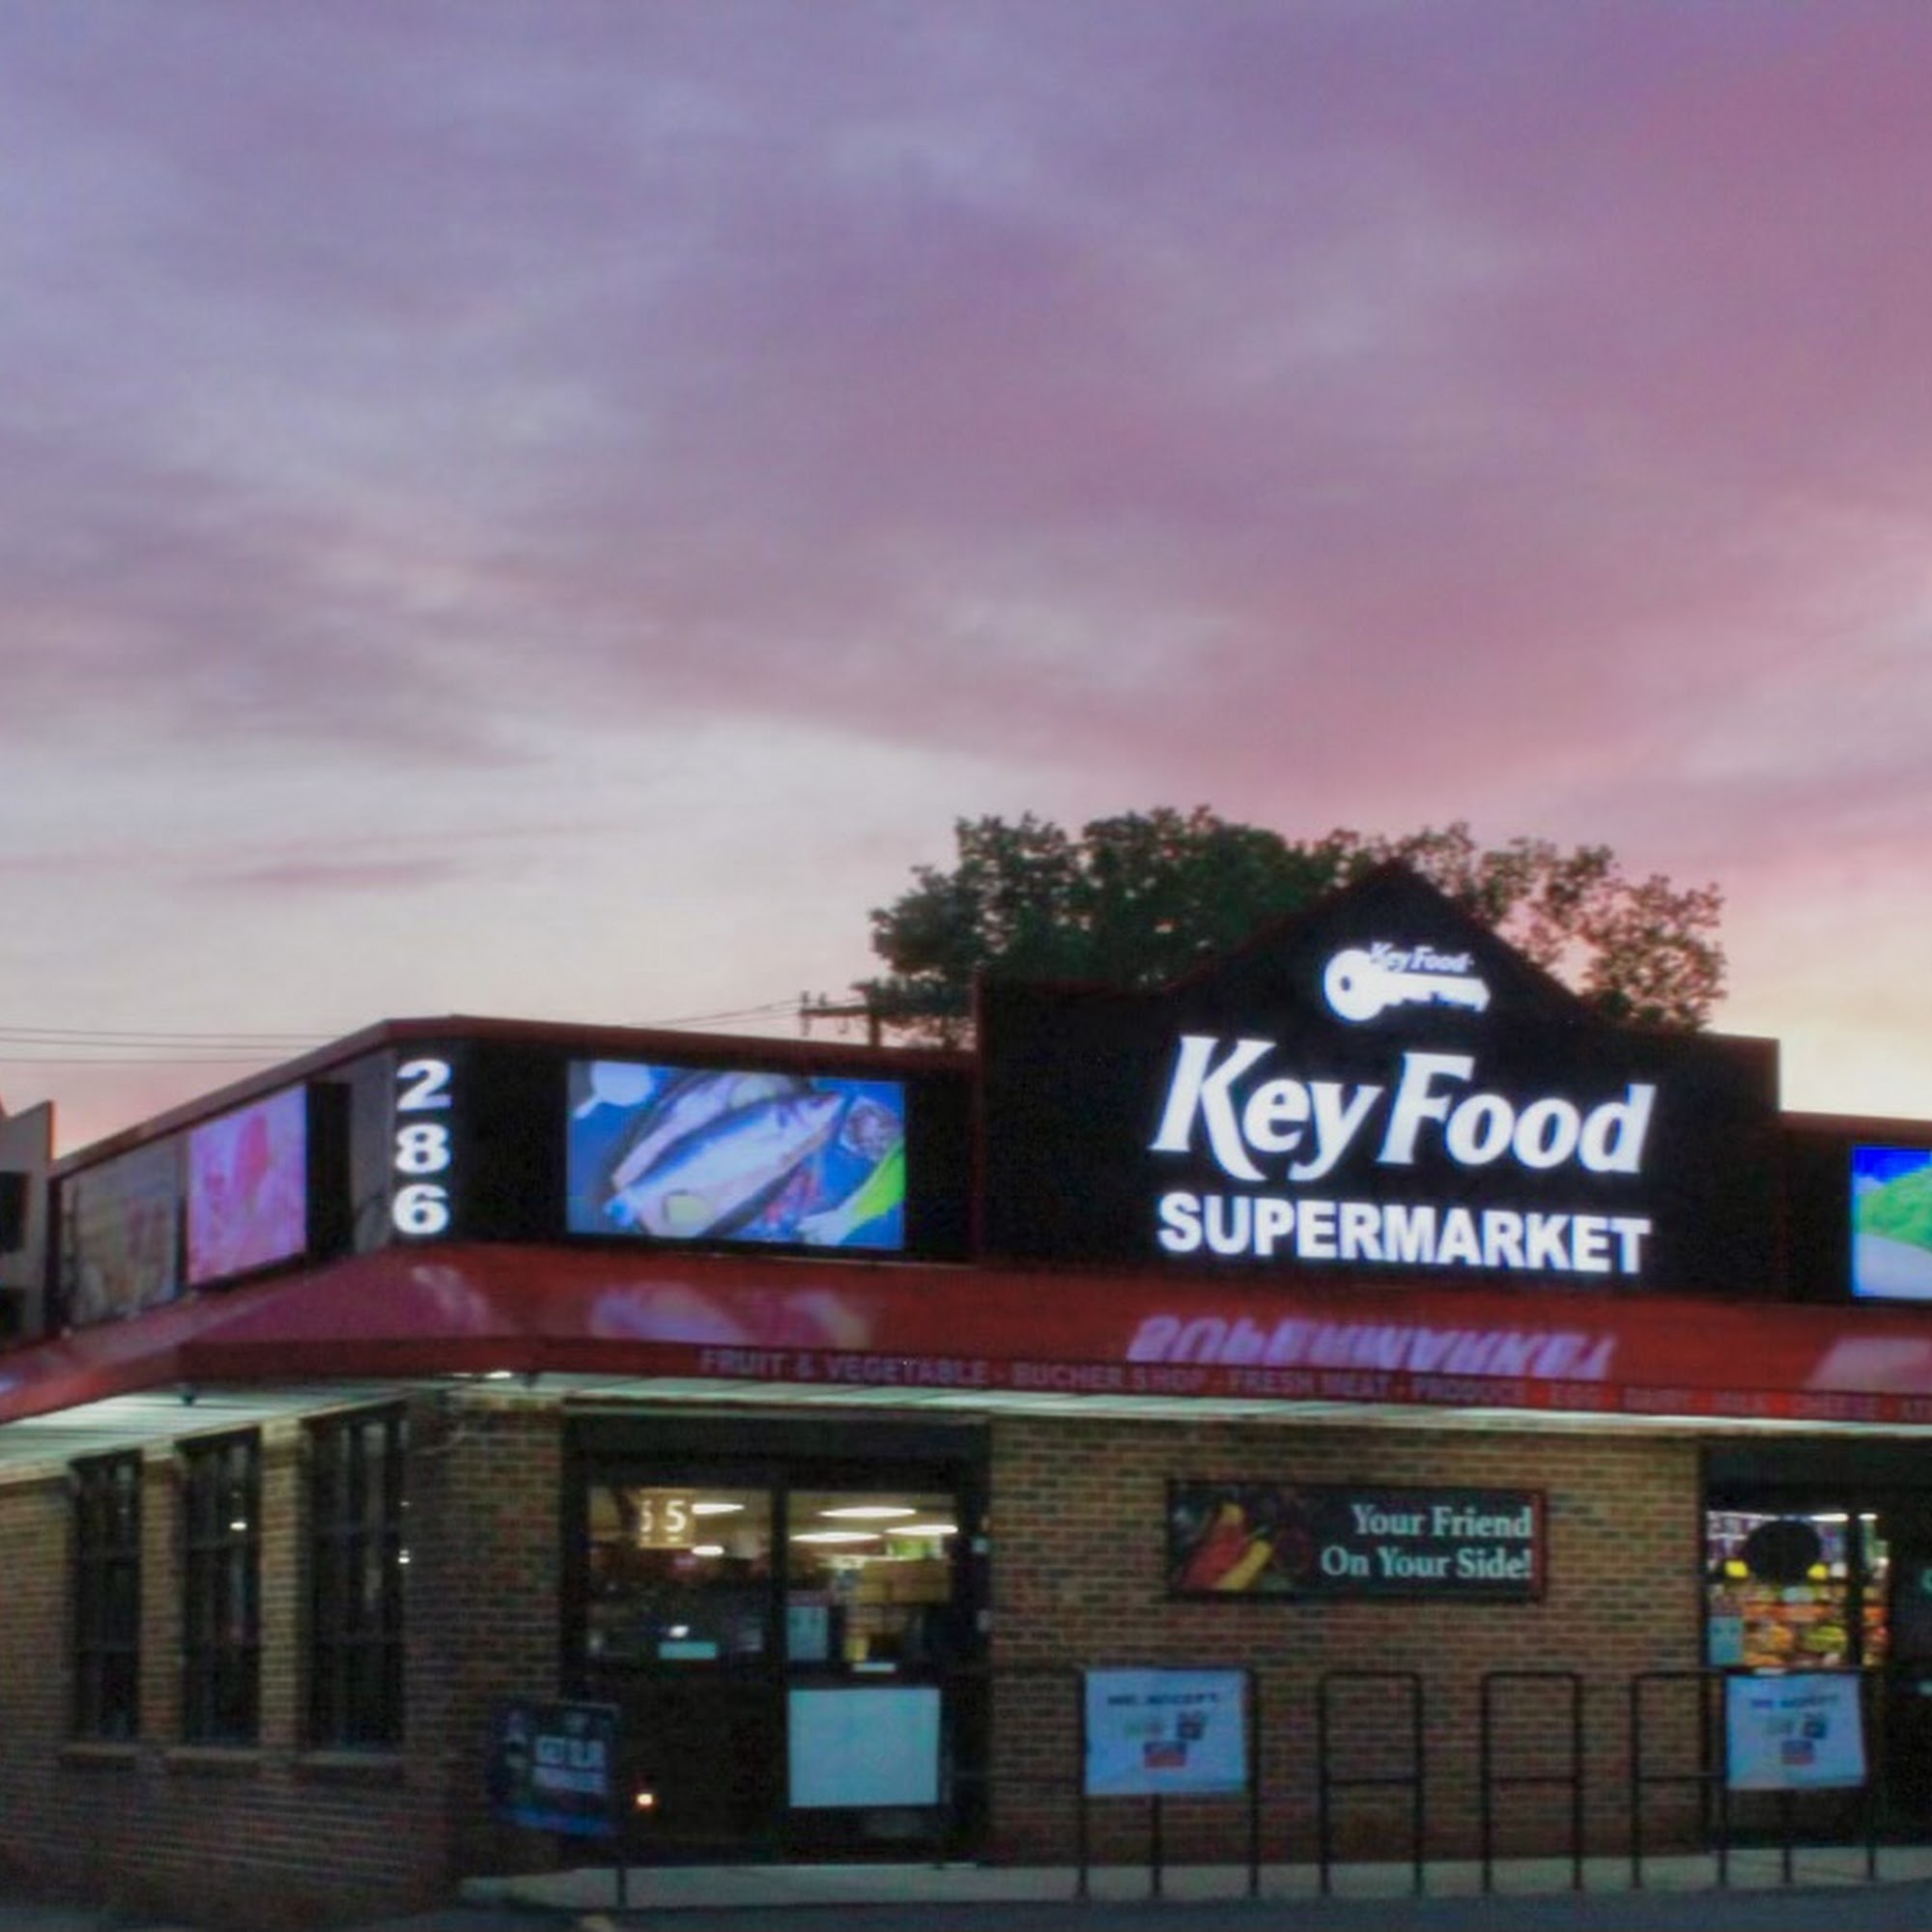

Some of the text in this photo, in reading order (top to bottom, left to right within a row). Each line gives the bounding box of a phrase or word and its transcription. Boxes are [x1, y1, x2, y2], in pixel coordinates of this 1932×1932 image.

[1370, 941, 1472, 974] Key Food
[1150, 1036, 1656, 1180] Key Food
[392, 1059, 453, 1235] 286
[1159, 1191, 1651, 1274] SUPERMARKET
[700, 1349, 787, 1377] FRUIT
[826, 1353, 989, 1384] VEGETABLE
[1351, 1504, 1533, 1538] Your Friend
[1321, 1547, 1532, 1578] On Your Side!
